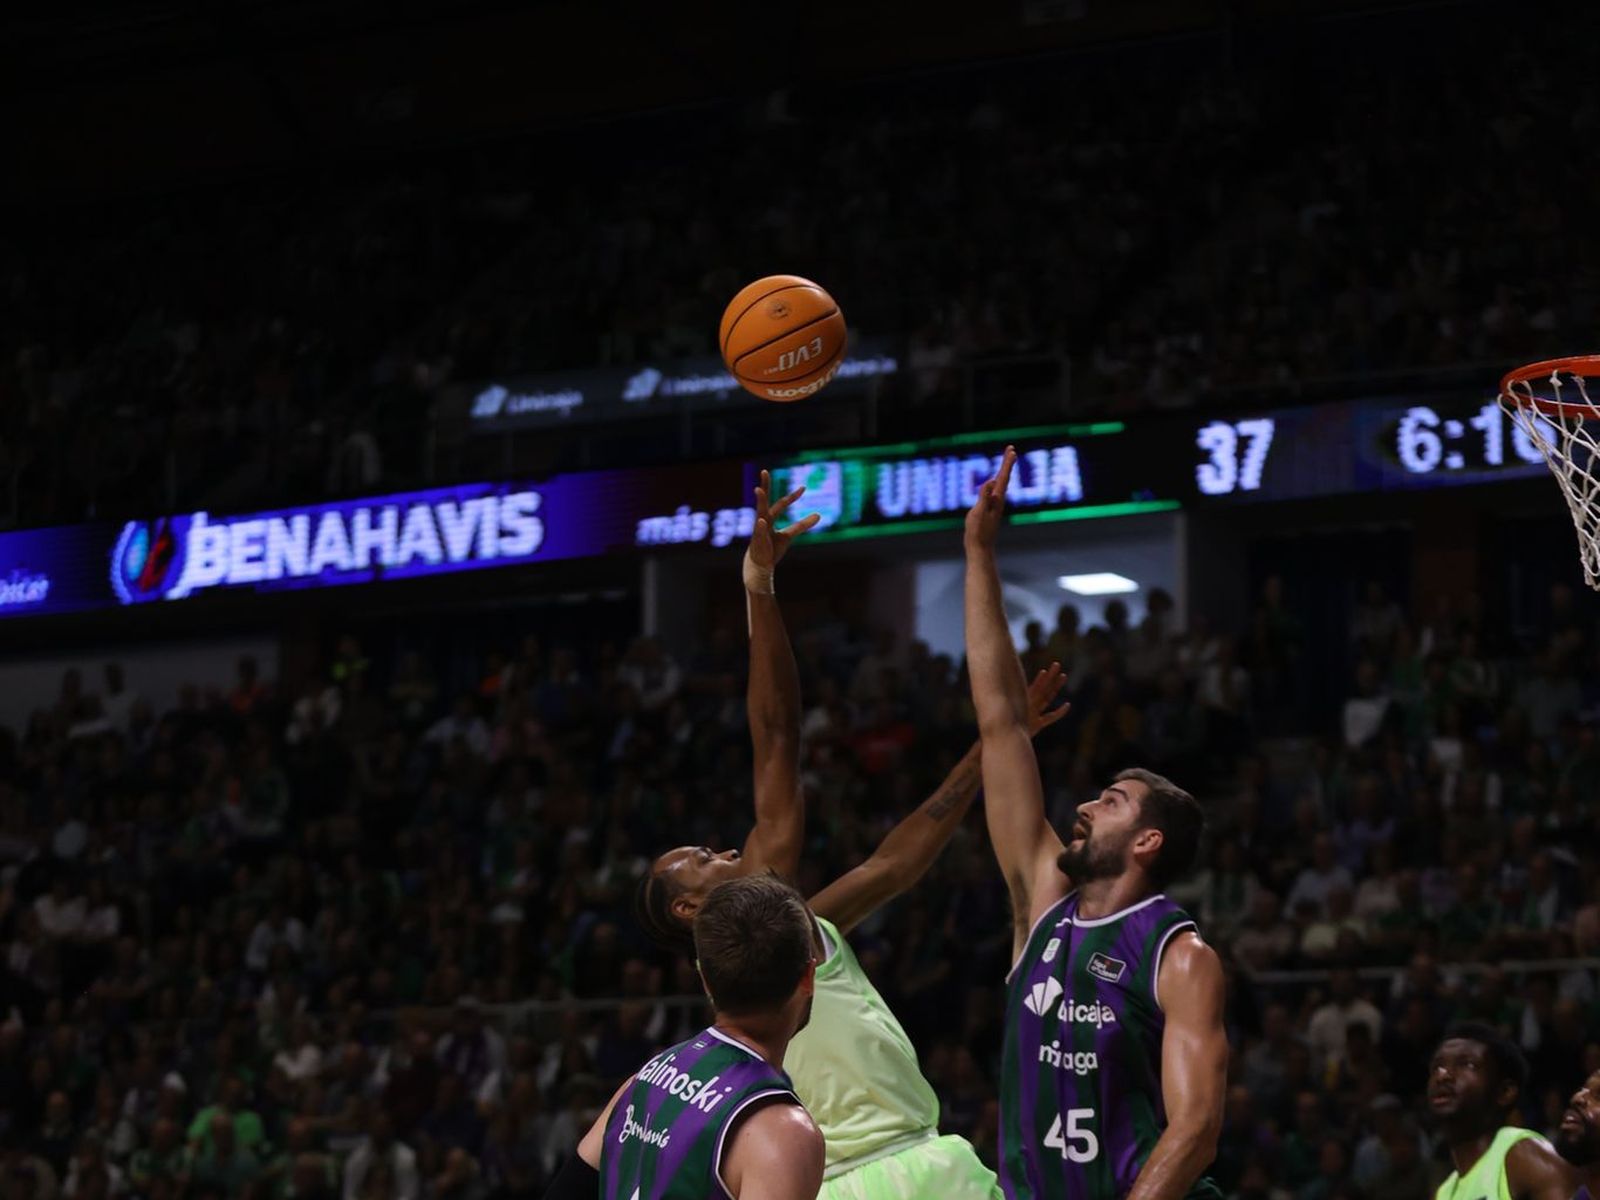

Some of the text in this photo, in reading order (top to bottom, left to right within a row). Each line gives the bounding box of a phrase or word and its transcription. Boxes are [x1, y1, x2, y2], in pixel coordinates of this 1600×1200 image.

[778, 337, 823, 372] EVO
[1195, 420, 1275, 494] 37
[165, 491, 543, 600] BENAHAVIS
[635, 1053, 733, 1113] alinoski
[1043, 1108, 1099, 1163] 45
